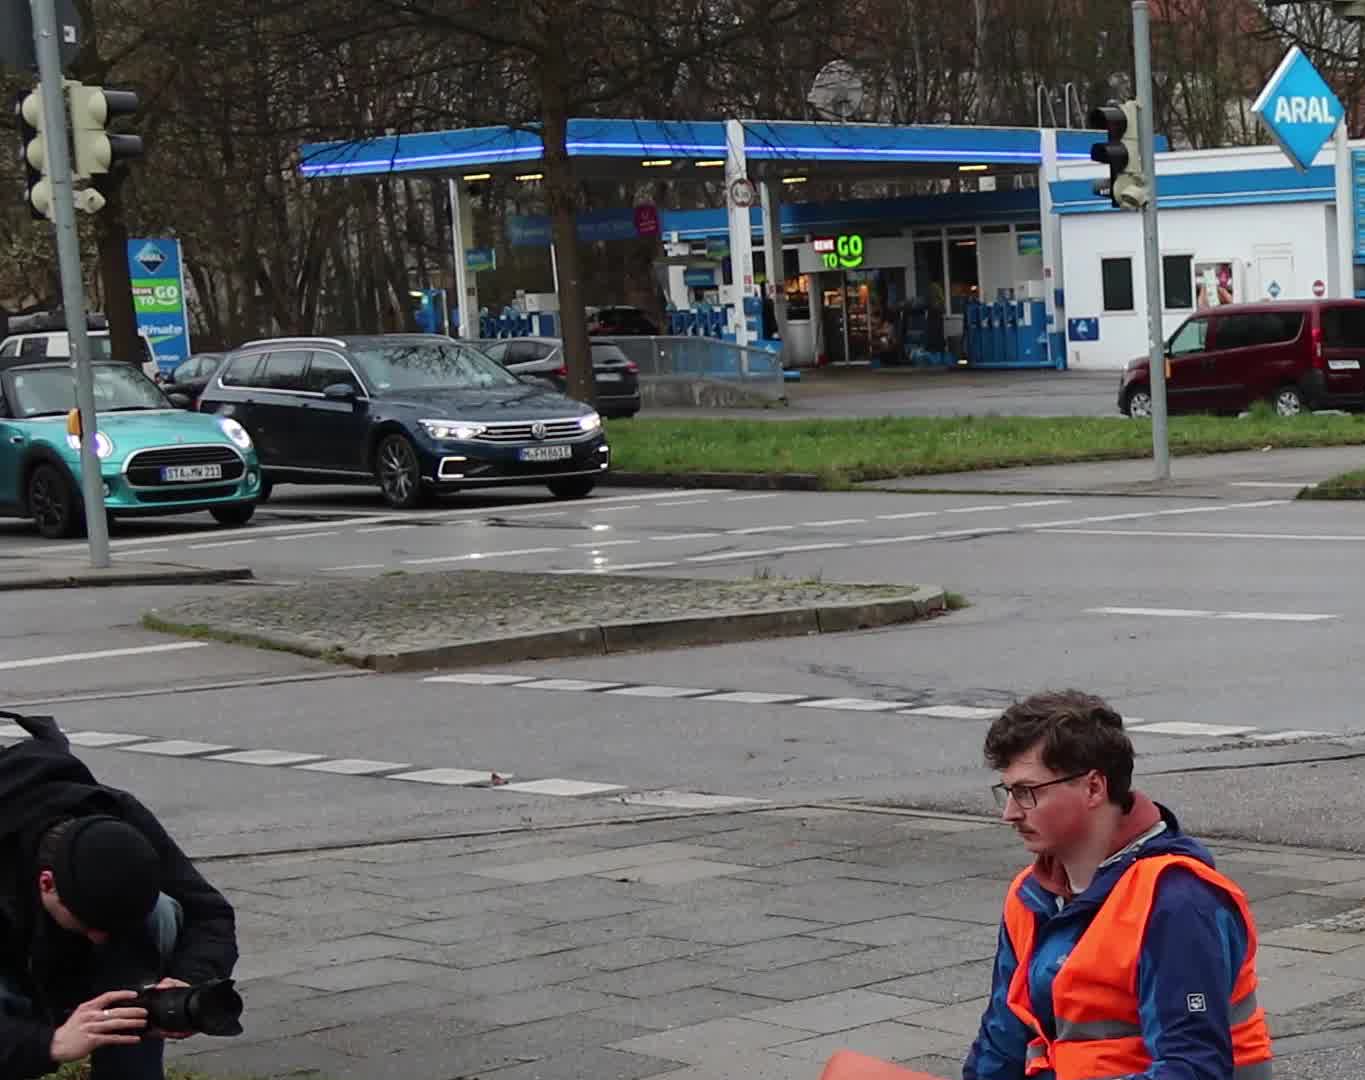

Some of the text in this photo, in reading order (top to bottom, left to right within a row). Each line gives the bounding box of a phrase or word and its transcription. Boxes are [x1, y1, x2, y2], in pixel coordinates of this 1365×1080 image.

[1274, 96, 1336, 124] ARAL
[823, 234, 863, 268] TO GO
[140, 286, 178, 305] TO GO
